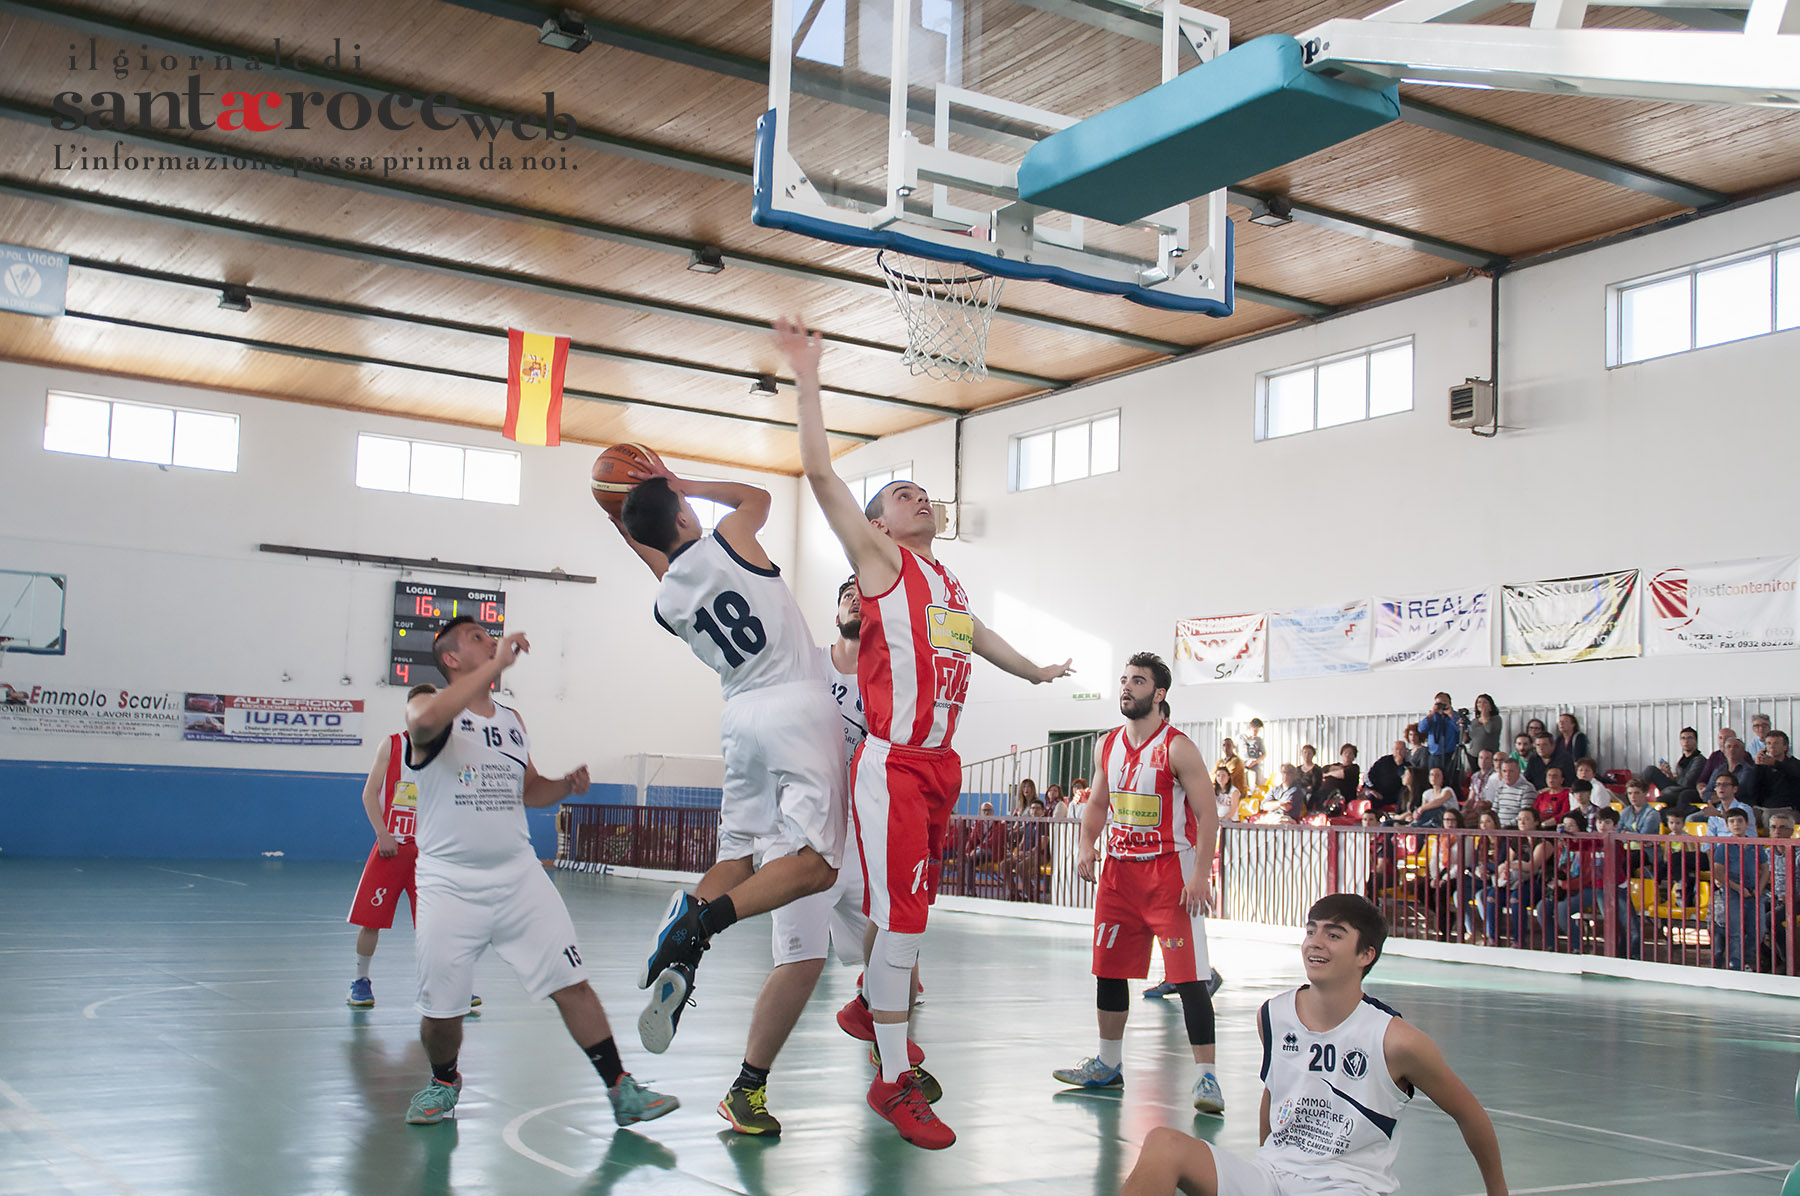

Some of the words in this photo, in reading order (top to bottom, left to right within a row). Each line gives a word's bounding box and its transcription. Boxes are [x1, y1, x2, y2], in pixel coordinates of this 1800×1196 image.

[26, 251, 64, 269] VIGOR
[405, 585, 437, 596] LOCALI
[467, 592, 497, 602] OSPITI
[415, 595, 433, 618] 16
[479, 602, 498, 623] 16
[1408, 593, 1488, 619] REALE
[692, 590, 768, 670] 18
[1719, 641, 1736, 649] Fax
[1737, 640, 1760, 649] 0932
[395, 663, 410, 684] 4
[29, 685, 108, 708] Emmolo
[117, 690, 170, 711] Scavi
[233, 696, 354, 707] AUTOFFICINA
[0, 704, 54, 716] OVIMENTO
[56, 708, 90, 717] TERRA
[96, 710, 132, 719] LAVORI
[133, 712, 181, 721] STRADALI
[245, 711, 342, 726] IURATO
[482, 726, 503, 748] 15
[1118, 761, 1144, 791] 11
[370, 887, 388, 907] 8
[1096, 921, 1121, 949] 11
[562, 944, 583, 969] 15
[1308, 1043, 1337, 1073] 20
